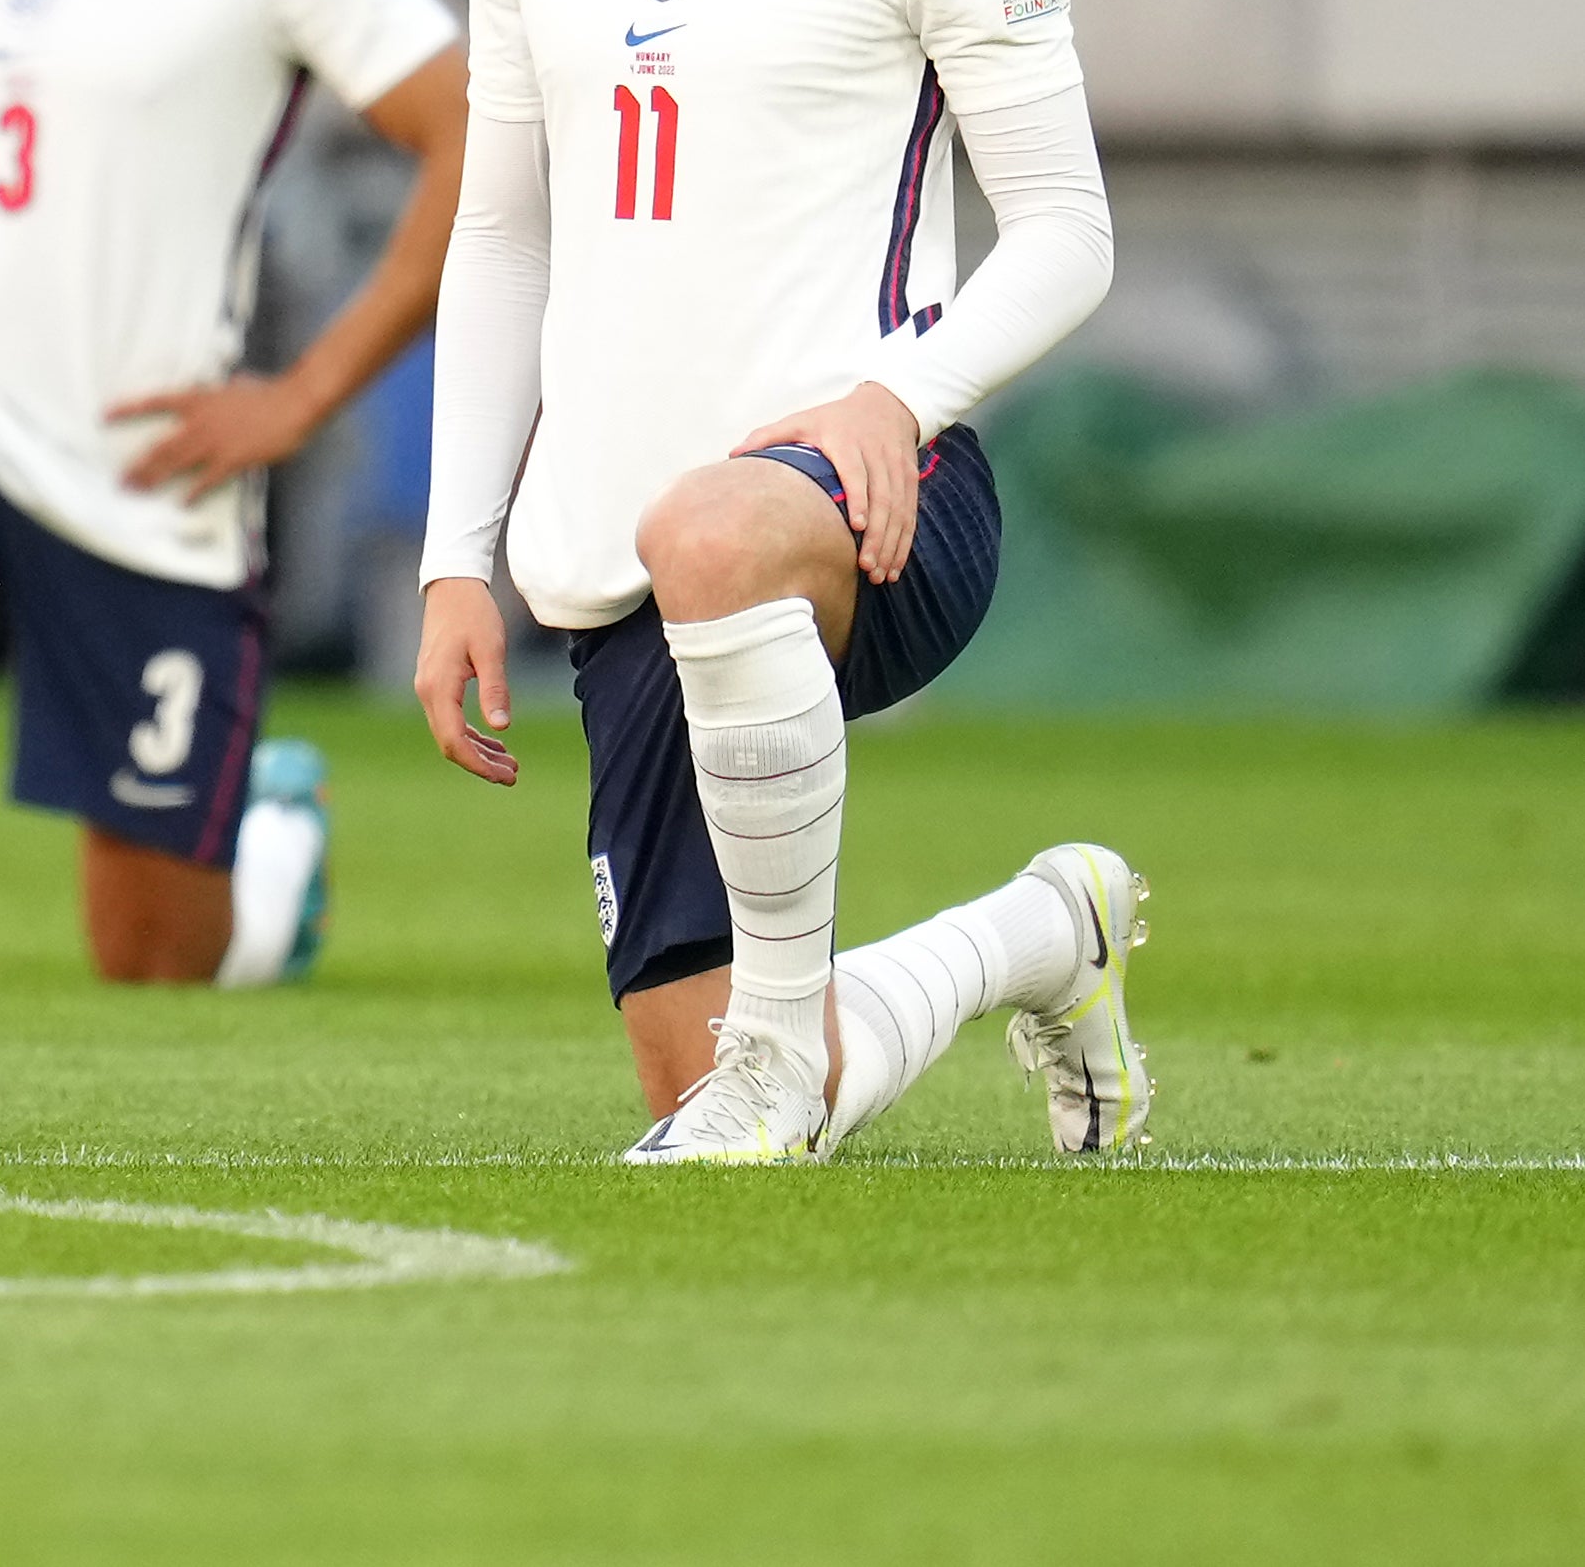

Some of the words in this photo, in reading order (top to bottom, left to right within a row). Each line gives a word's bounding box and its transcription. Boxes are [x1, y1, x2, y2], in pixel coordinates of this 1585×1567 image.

[635, 51, 671, 62] HUNGARY
[637, 64, 656, 75] JUNE
[658, 64, 675, 76] 2022
[613, 84, 679, 221] 11
[129, 647, 204, 775] 3
